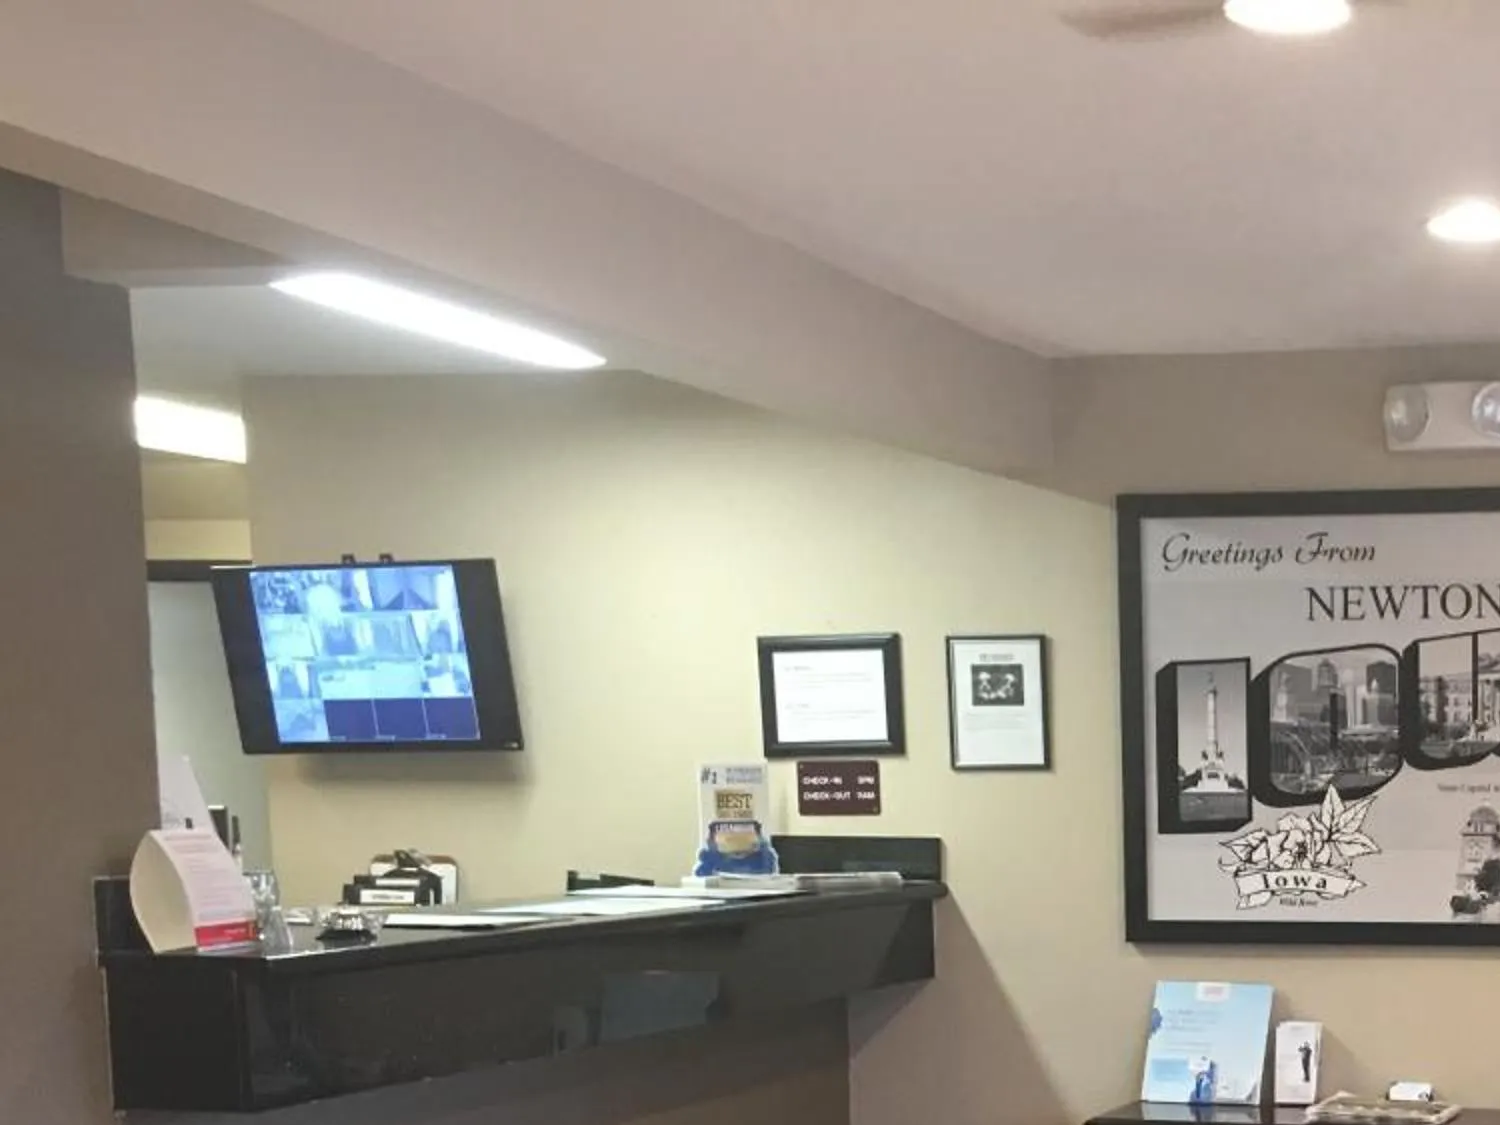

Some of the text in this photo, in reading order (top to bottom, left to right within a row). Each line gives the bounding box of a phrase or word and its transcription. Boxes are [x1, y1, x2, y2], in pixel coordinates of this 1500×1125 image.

[1162, 531, 1377, 572] Greetings From
[716, 793, 753, 810] BEST
[1262, 873, 1327, 889] Iowa
